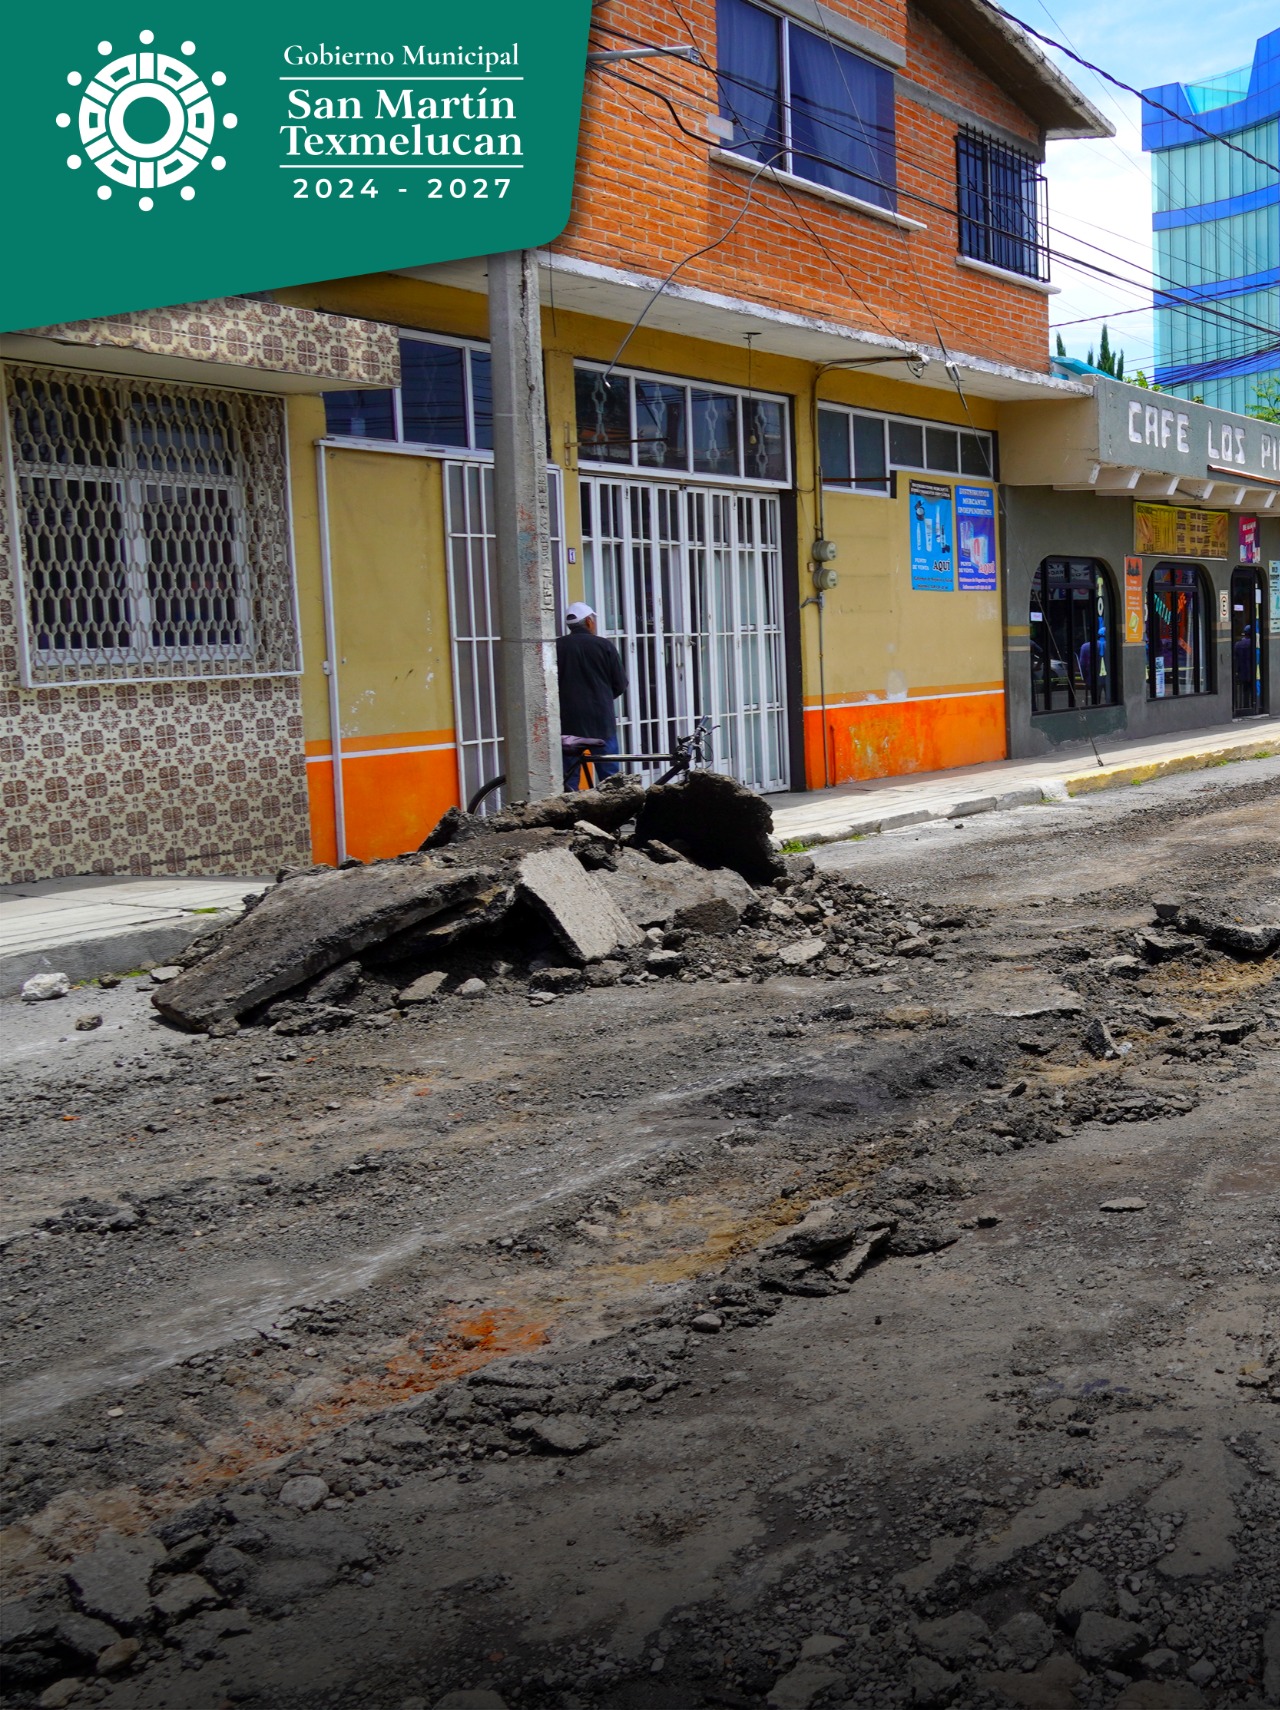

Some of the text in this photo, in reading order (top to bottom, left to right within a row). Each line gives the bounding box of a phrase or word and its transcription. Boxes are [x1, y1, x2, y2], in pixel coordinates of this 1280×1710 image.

[1128, 401, 1190, 453] CAFE
[1208, 420, 1246, 464] LOS
[933, 558, 951, 573] AQUÍ
